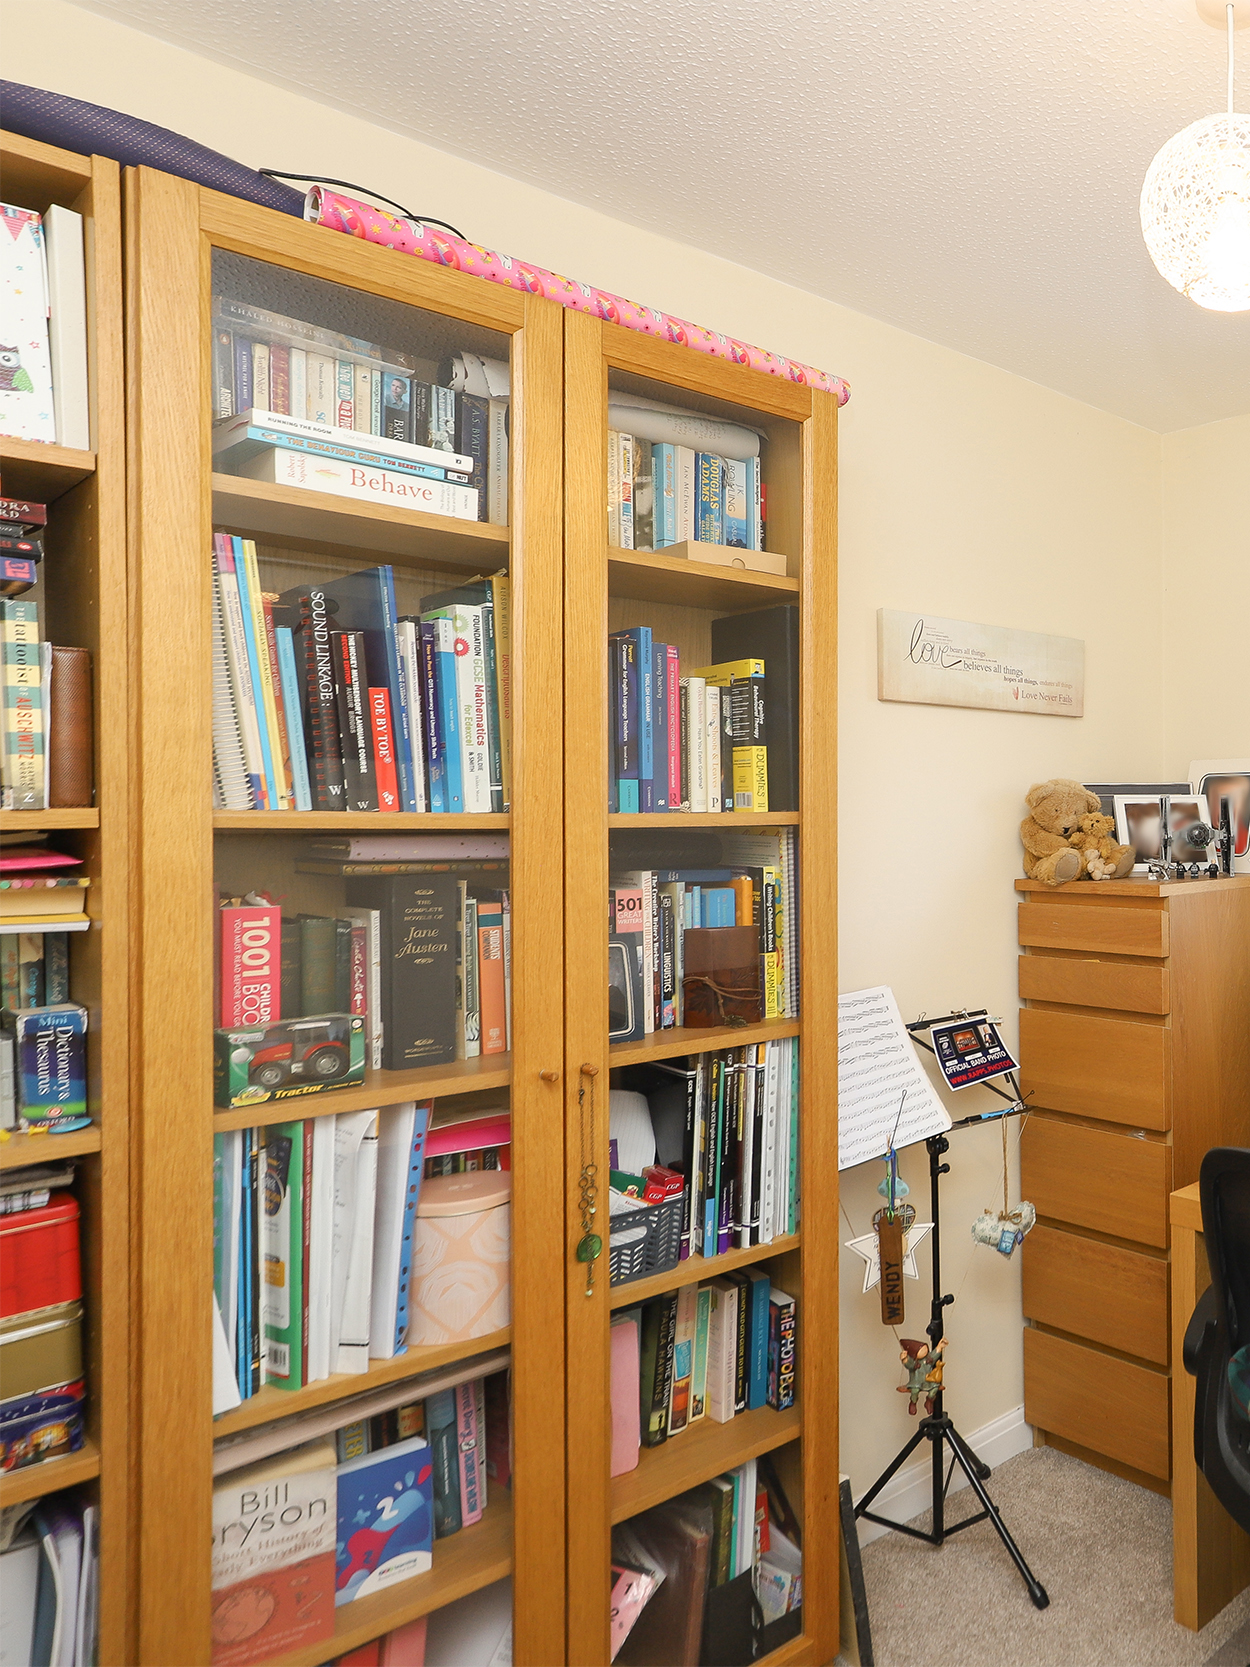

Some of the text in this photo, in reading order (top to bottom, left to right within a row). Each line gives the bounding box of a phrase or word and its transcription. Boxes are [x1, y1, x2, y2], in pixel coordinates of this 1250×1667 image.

[230, 305, 325, 339] KHALED HOSSEINI
[267, 416, 333, 436] RUNNING THE ROOM
[286, 437, 381, 464] THE BEHAVIOUR GURU
[471, 427, 481, 458] BYATT
[286, 455, 296, 479] Robert
[383, 458, 426, 472] TOM BENNETT
[350, 468, 433, 501] Behave
[701, 460, 710, 502] ADAMS
[709, 458, 720, 510] DOUGLAS
[728, 465, 736, 513] ROWLING
[310, 591, 329, 642] SOUND
[499, 586, 509, 640] ALISON WILCOX
[15, 623, 32, 684] tattooist
[256, 610, 271, 687] SOCIALLY SPEAKING
[341, 634, 349, 659] SECOND
[903, 619, 963, 669] love
[342, 660, 351, 685] EDITION
[472, 614, 486, 746] FOUNDATION GCSE Mathematics
[963, 660, 1024, 677] believes all things
[1003, 675, 1017, 684] hopes
[347, 634, 368, 774] THE HICKEY MULTISENSORY LANGUAGE COURSE
[373, 692, 385, 716] TOE
[752, 685, 760, 718] Behavioural
[1021, 690, 1073, 704] Love Never Fails
[15, 696, 35, 760] AUSCHWITZ
[375, 717, 387, 733] BY
[464, 704, 474, 747] for Edexcel
[322, 709, 341, 774] HATCHER
[756, 753, 766, 798] DUMMIES
[404, 906, 444, 914] COMPLETE
[616, 898, 642, 912] 501
[617, 911, 643, 920] GREAT
[233, 917, 241, 934] YOU
[403, 926, 440, 943] Jane
[617, 917, 643, 926] WRITERS
[652, 916, 660, 942] Writer's
[233, 934, 241, 954] MUST
[241, 916, 272, 978] 1001
[394, 942, 449, 959] Austen
[481, 930, 491, 961] COMPANION
[489, 929, 501, 960] STUDENTS
[652, 942, 660, 973] Workshop
[233, 955, 241, 973] READ
[663, 951, 672, 993] LINGUISTICS
[233, 973, 241, 1000] BEFORE
[766, 960, 776, 1004] DUMMIES
[233, 1000, 241, 1015] YOU
[38, 1015, 68, 1028] Mini
[36, 1026, 56, 1096] Thesaurus
[945, 1051, 1007, 1075] OFFICIAL BAND PHOTO
[274, 1083, 325, 1099] Tractor
[709, 1123, 717, 1139] English
[708, 1148, 716, 1165] English
[648, 1192, 663, 1200] CGP
[666, 1183, 681, 1191] CGP
[706, 1220, 714, 1237] Higher
[886, 1260, 901, 1321] WENDY
[654, 1310, 669, 1402] PAULA HAWKINS
[661, 1298, 678, 1408] THE GIRL ON THE TRAIN
[777, 1303, 796, 1410] THE PHOTO BOOK
[240, 1482, 289, 1517] Bill
[258, 1530, 311, 1550] History
[312, 1523, 326, 1535] of
[248, 1538, 324, 1565] Everything
